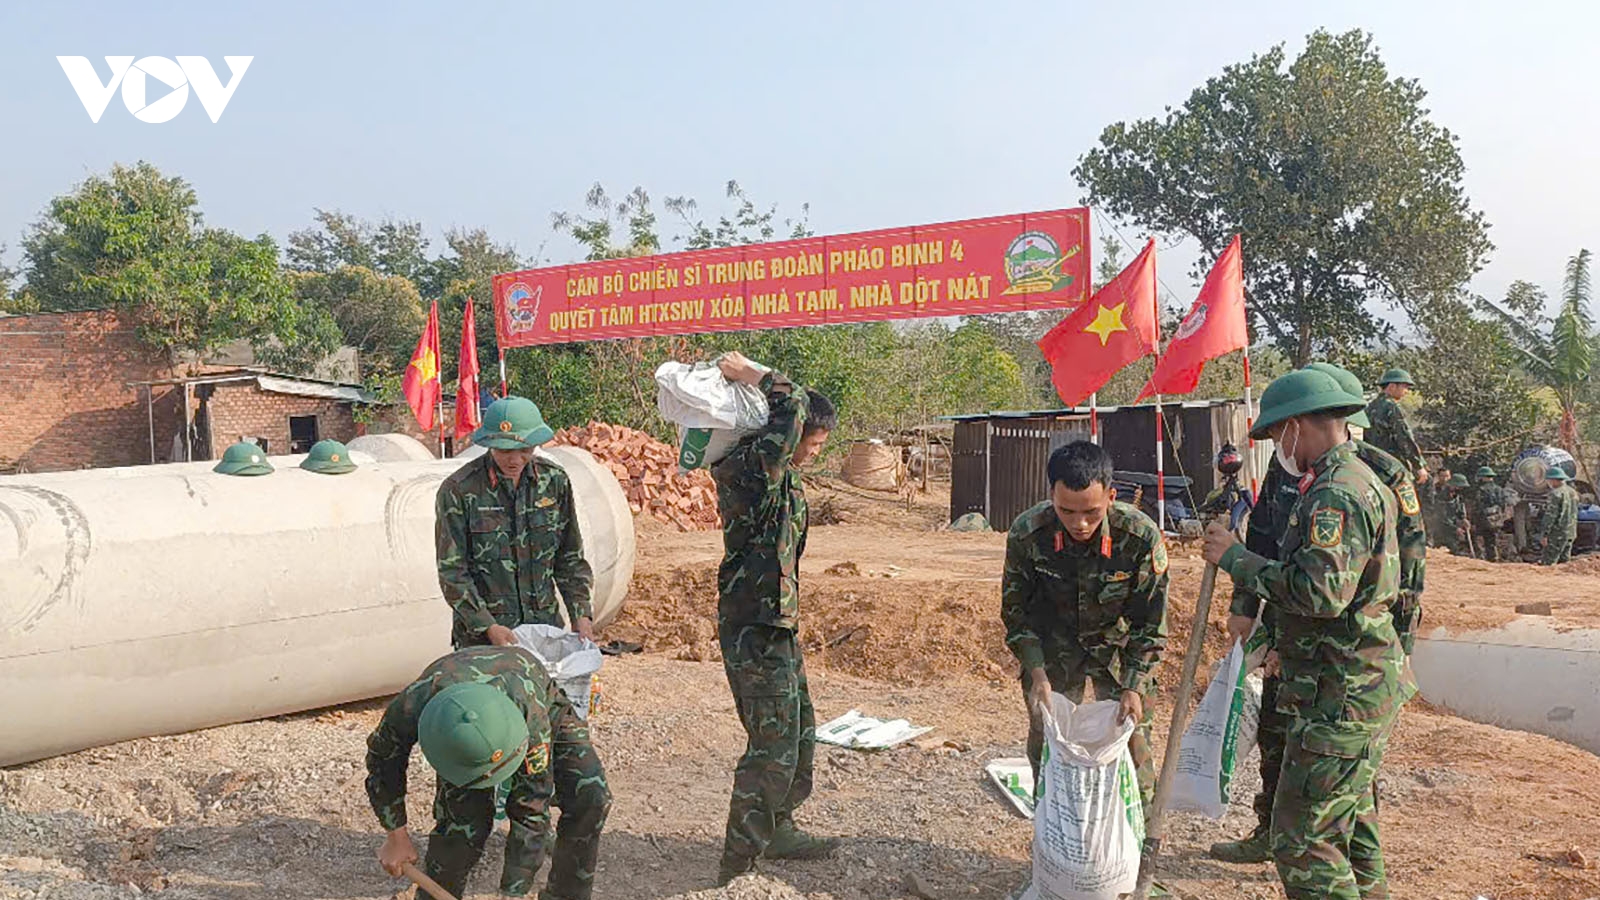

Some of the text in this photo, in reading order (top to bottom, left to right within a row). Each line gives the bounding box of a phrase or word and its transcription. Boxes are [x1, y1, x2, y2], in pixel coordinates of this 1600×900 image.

[567, 274, 598, 297] CÁN
[603, 270, 624, 297] BỘ
[629, 263, 679, 292] CHIẾN
[684, 262, 702, 286] SĨ
[706, 260, 766, 284] TRUNG
[771, 250, 824, 279] ĐOÀN
[830, 244, 885, 273] PHÁO
[891, 240, 943, 268] BINH
[950, 239, 964, 262] 4
[550, 272, 992, 332] QUYẾT TÂM HTXSNV XÓA NHÀ TẠM, NHÀ DỘT NÁT
